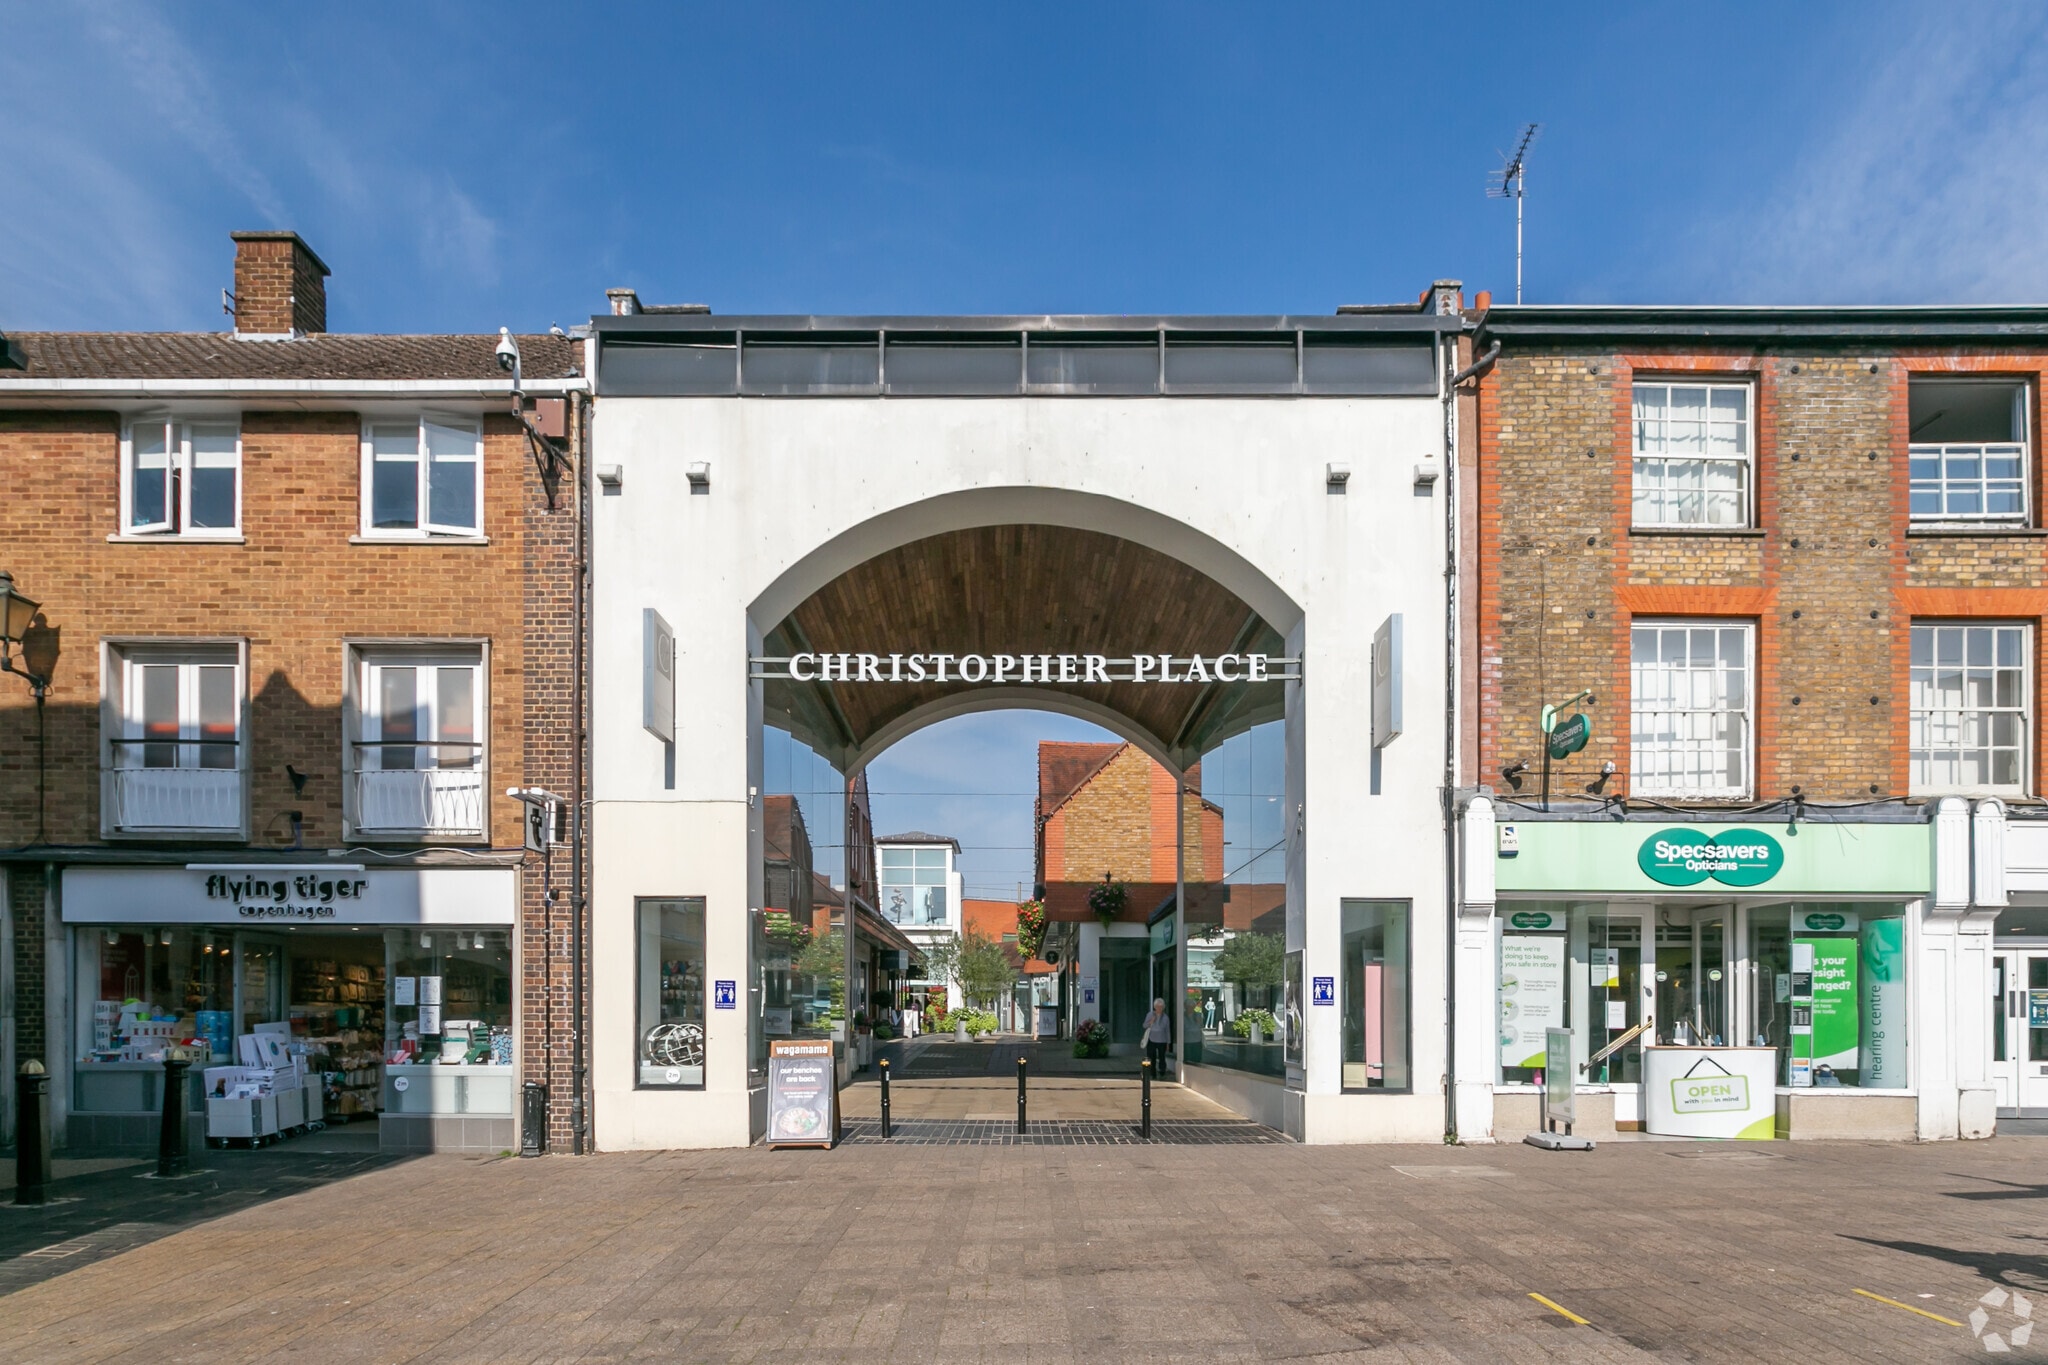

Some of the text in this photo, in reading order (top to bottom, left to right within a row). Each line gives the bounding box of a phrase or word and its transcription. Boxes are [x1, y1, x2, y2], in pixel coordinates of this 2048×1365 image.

[788, 652, 1268, 683] CHRISTOPHER PLACE
[1552, 723, 1583, 745] Specsavers
[1655, 840, 1769, 862] Specsavers
[1685, 860, 1738, 872] Opticians
[205, 874, 369, 903] flying tiger
[239, 904, 336, 919] copenhagen
[1821, 957, 1847, 967] your
[1813, 967, 1845, 979] esight
[1813, 981, 1851, 992] anged?
[1870, 985, 1885, 1080] hearing centre
[776, 1045, 828, 1057] wagamama
[1688, 1084, 1731, 1097] OPEN
